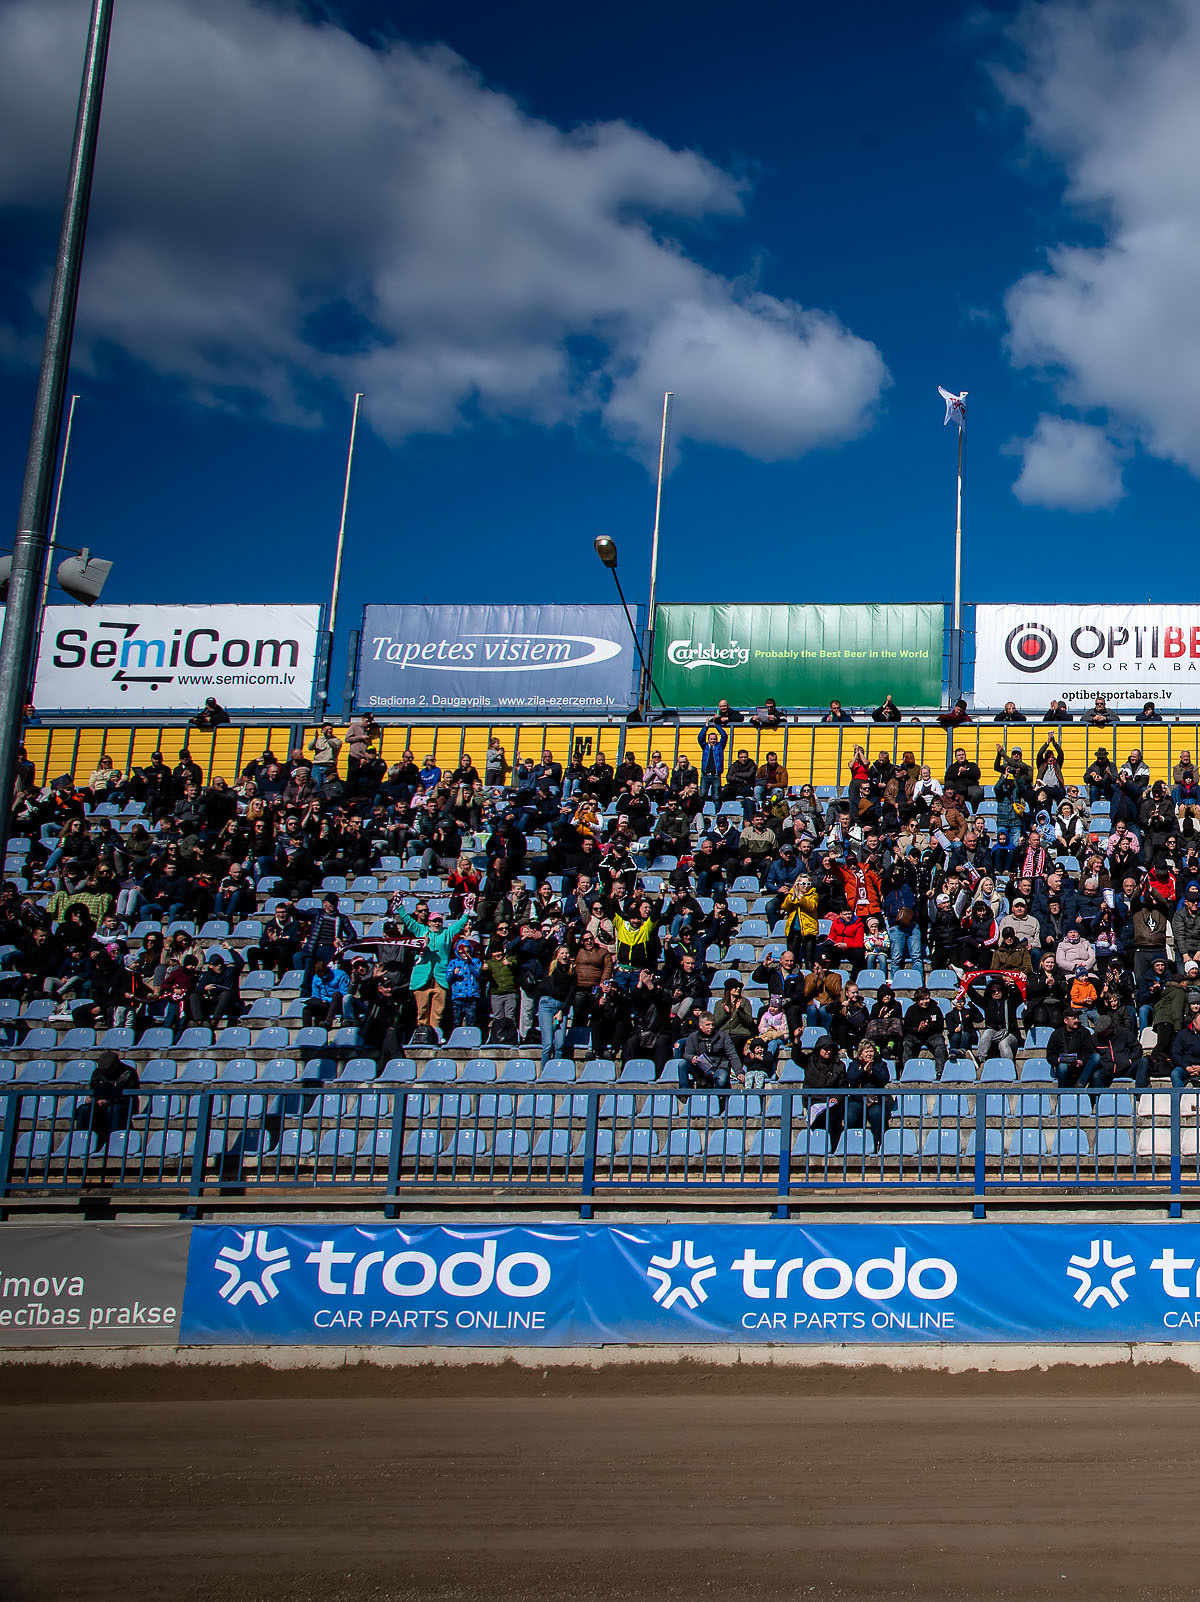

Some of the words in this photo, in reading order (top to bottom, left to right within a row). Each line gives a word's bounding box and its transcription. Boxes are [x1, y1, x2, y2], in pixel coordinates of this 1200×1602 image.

[53, 629, 299, 668] SemiCom
[372, 637, 476, 669] Tapetes
[484, 639, 571, 661] visiem
[667, 640, 750, 667] Carlsberg
[754, 650, 798, 660] Probably
[800, 650, 816, 658] the
[820, 650, 840, 658] Best
[844, 650, 867, 658] Beer
[870, 650, 879, 658] in
[880, 650, 897, 658] the
[899, 650, 929, 658] World
[1072, 662, 1157, 672] SPORTA
[178, 673, 296, 685] www.semicom.lv
[370, 695, 416, 706] Stadiona
[432, 695, 490, 708] Daugavpils
[498, 696, 615, 706] www.zila-ezerzeme.lv
[1062, 689, 1172, 703] optibetsportabars.lv
[305, 1240, 551, 1298] trodo
[730, 1246, 958, 1300] trodo
[0, 1303, 81, 1326] ecības
[89, 1302, 176, 1330] prakse
[314, 1310, 362, 1328] CAR
[370, 1310, 448, 1328] PARTS
[456, 1311, 546, 1329] ONLINE
[741, 1312, 786, 1329] CAR
[794, 1312, 866, 1329] PARTS
[872, 1312, 955, 1329] ONLINE
